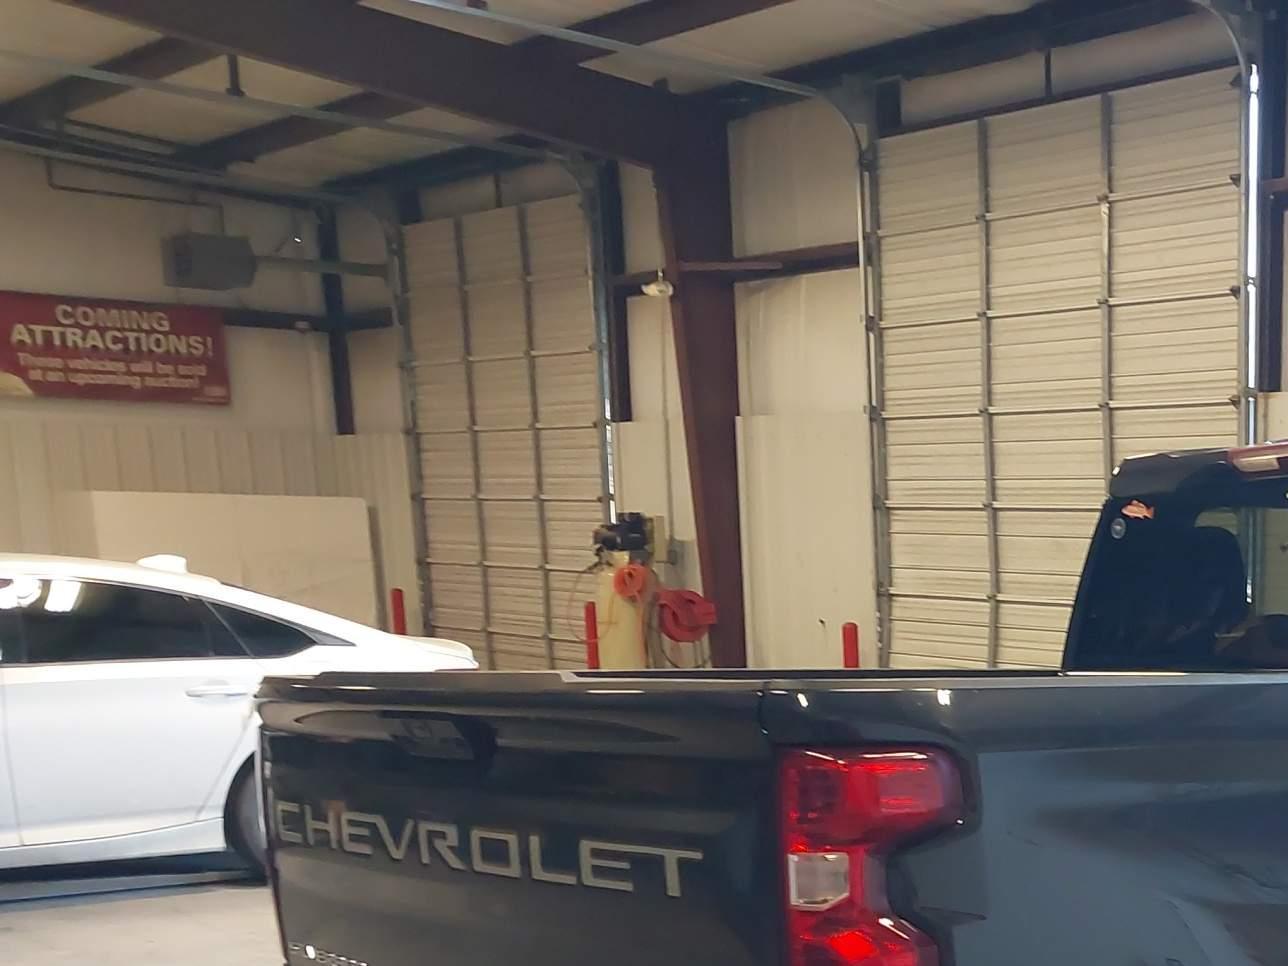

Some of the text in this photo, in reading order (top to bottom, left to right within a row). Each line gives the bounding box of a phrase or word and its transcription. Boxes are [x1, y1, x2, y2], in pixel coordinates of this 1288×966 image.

[55, 304, 170, 331] COMING
[10, 324, 213, 356] ATTRACTIONS!
[275, 801, 704, 896] CHEVROLET
